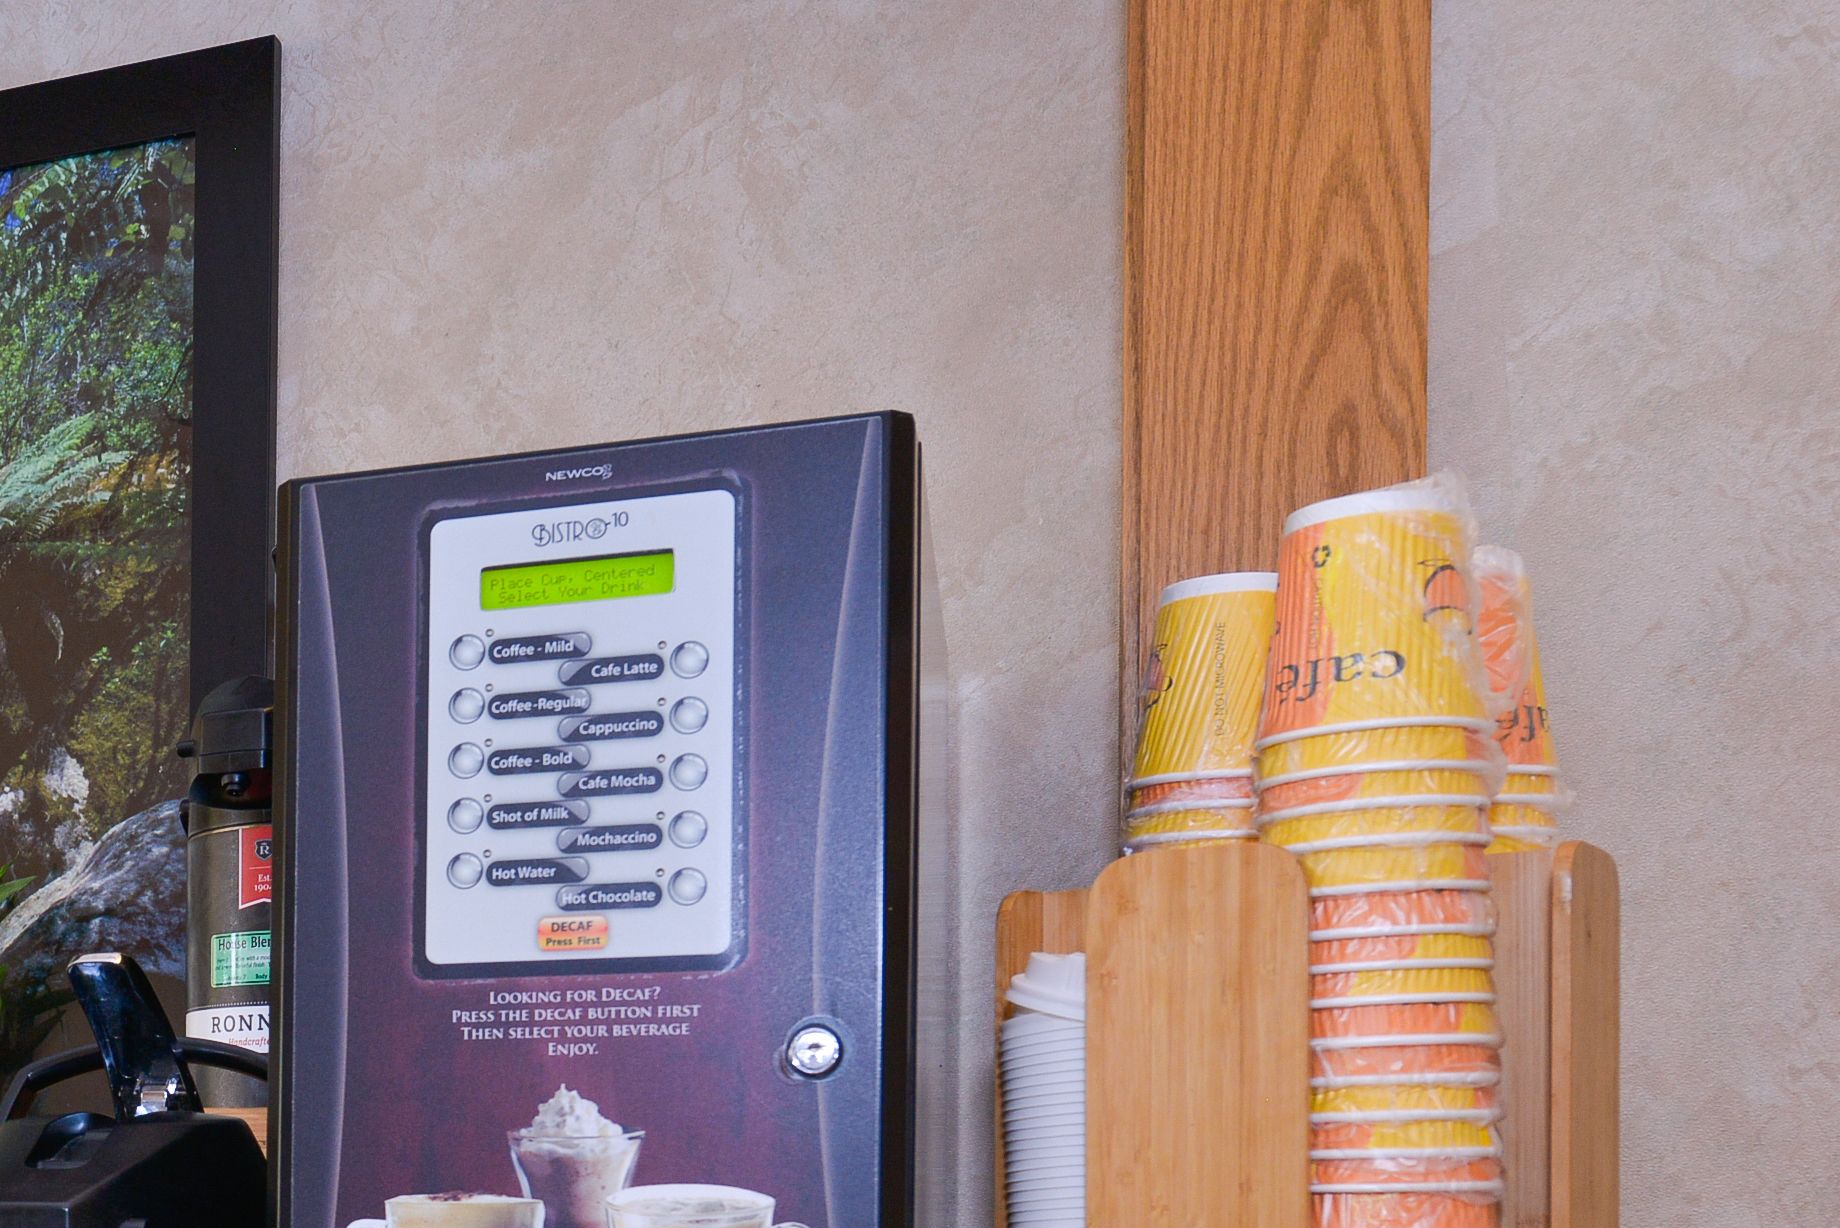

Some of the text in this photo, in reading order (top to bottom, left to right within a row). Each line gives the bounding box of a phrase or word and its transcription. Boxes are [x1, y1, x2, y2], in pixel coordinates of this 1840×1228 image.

[545, 466, 603, 482] NEWCO
[490, 577, 533, 591] Place
[584, 564, 656, 582] Centered
[499, 580, 645, 604] Select Your Drink
[493, 643, 535, 658] Coffee
[545, 639, 574, 654] Mild
[1215, 622, 1226, 690] MICROWAVE
[591, 661, 658, 678] Cafe Latte
[1215, 693, 1226, 716] NOT
[579, 719, 658, 736] Cappuccino
[491, 754, 533, 769] Coffee
[542, 752, 573, 766] Bold
[578, 773, 656, 790] Cafe Mocha
[492, 807, 569, 824] Shot of Milk
[577, 831, 657, 846] Mochaccino
[492, 866, 556, 880] Hot Water
[562, 889, 656, 905] Hot Chocolate
[551, 920, 593, 933] DECAF
[250, 936, 271, 949] Ble
[545, 935, 600, 946] Press First
[489, 986, 661, 1005] LOOKING FOR DECAF?
[452, 1004, 702, 1023] PRESS THE DECAF BUTTON FIRST
[211, 1013, 270, 1034] RONN
[461, 1022, 691, 1040] THEN SELECT YOUR BEVERAGE
[548, 1042, 599, 1058] ENJOY.
